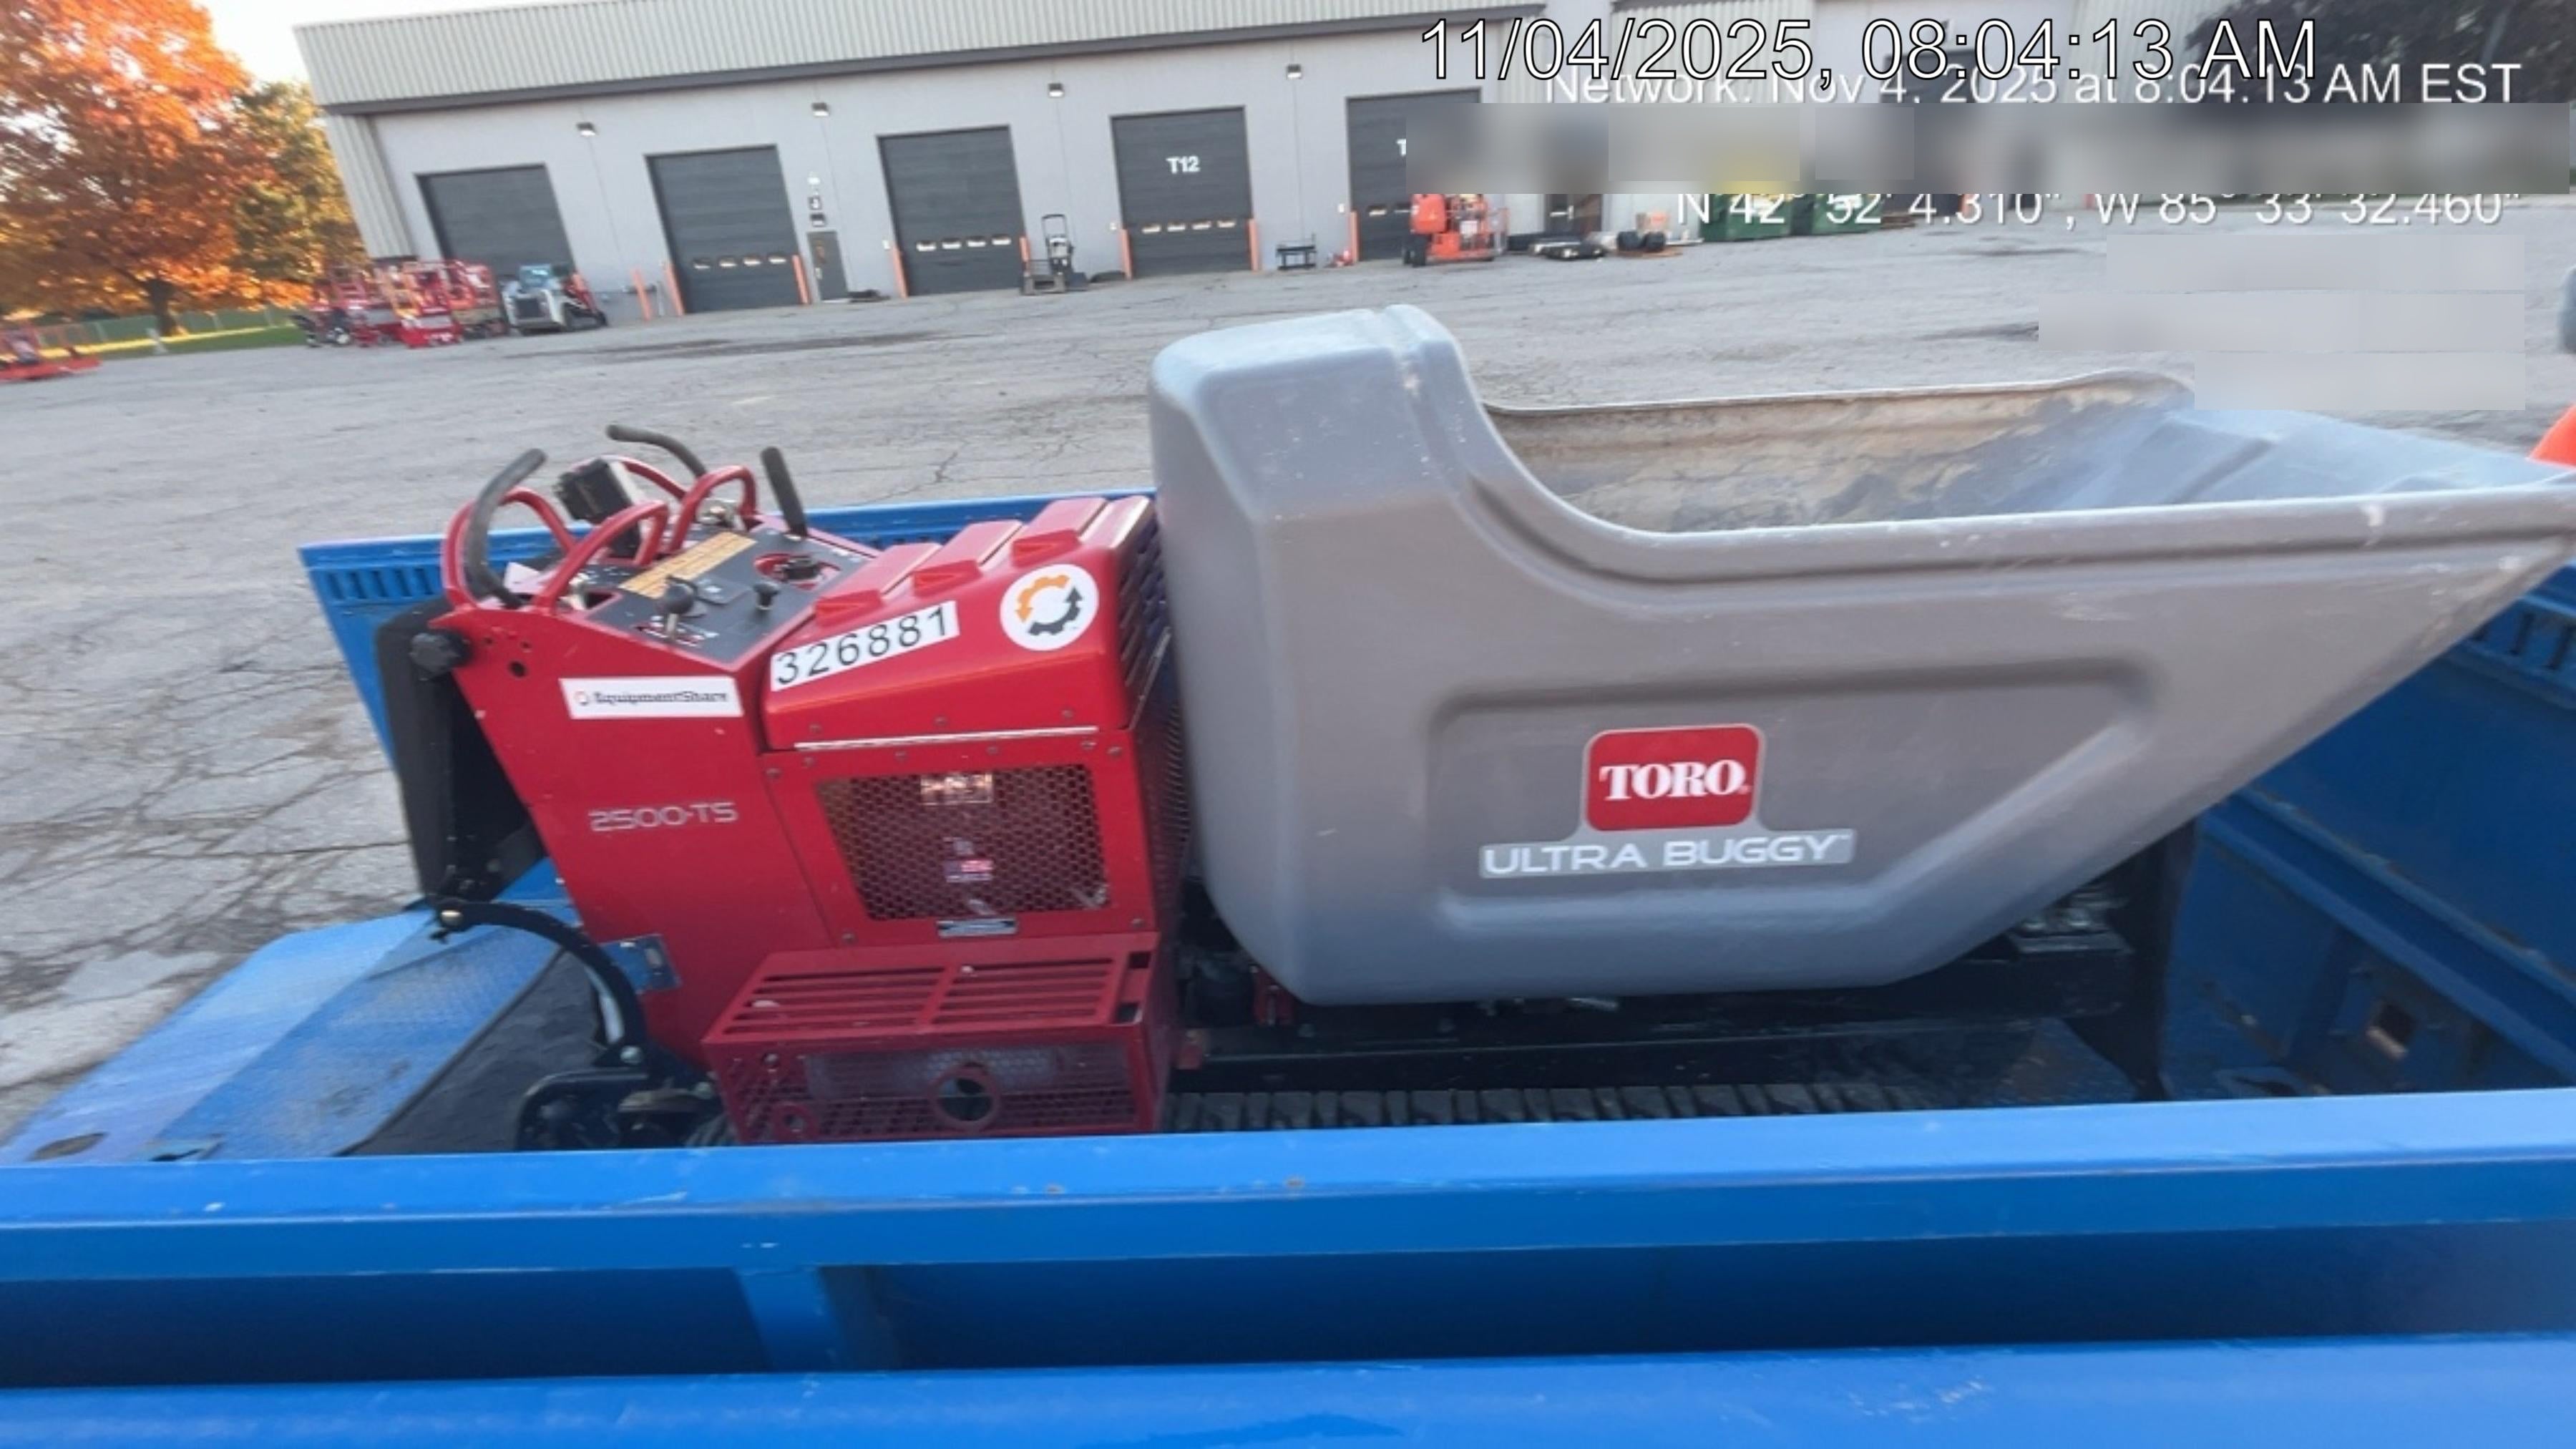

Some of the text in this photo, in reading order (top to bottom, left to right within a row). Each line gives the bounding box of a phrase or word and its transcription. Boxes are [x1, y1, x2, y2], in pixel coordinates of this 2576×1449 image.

[1166, 155, 1201, 174] T12
[777, 606, 946, 685] 326881
[1599, 758, 1747, 801] TORO
[1484, 834, 1837, 874] ULTRA BUGGY
